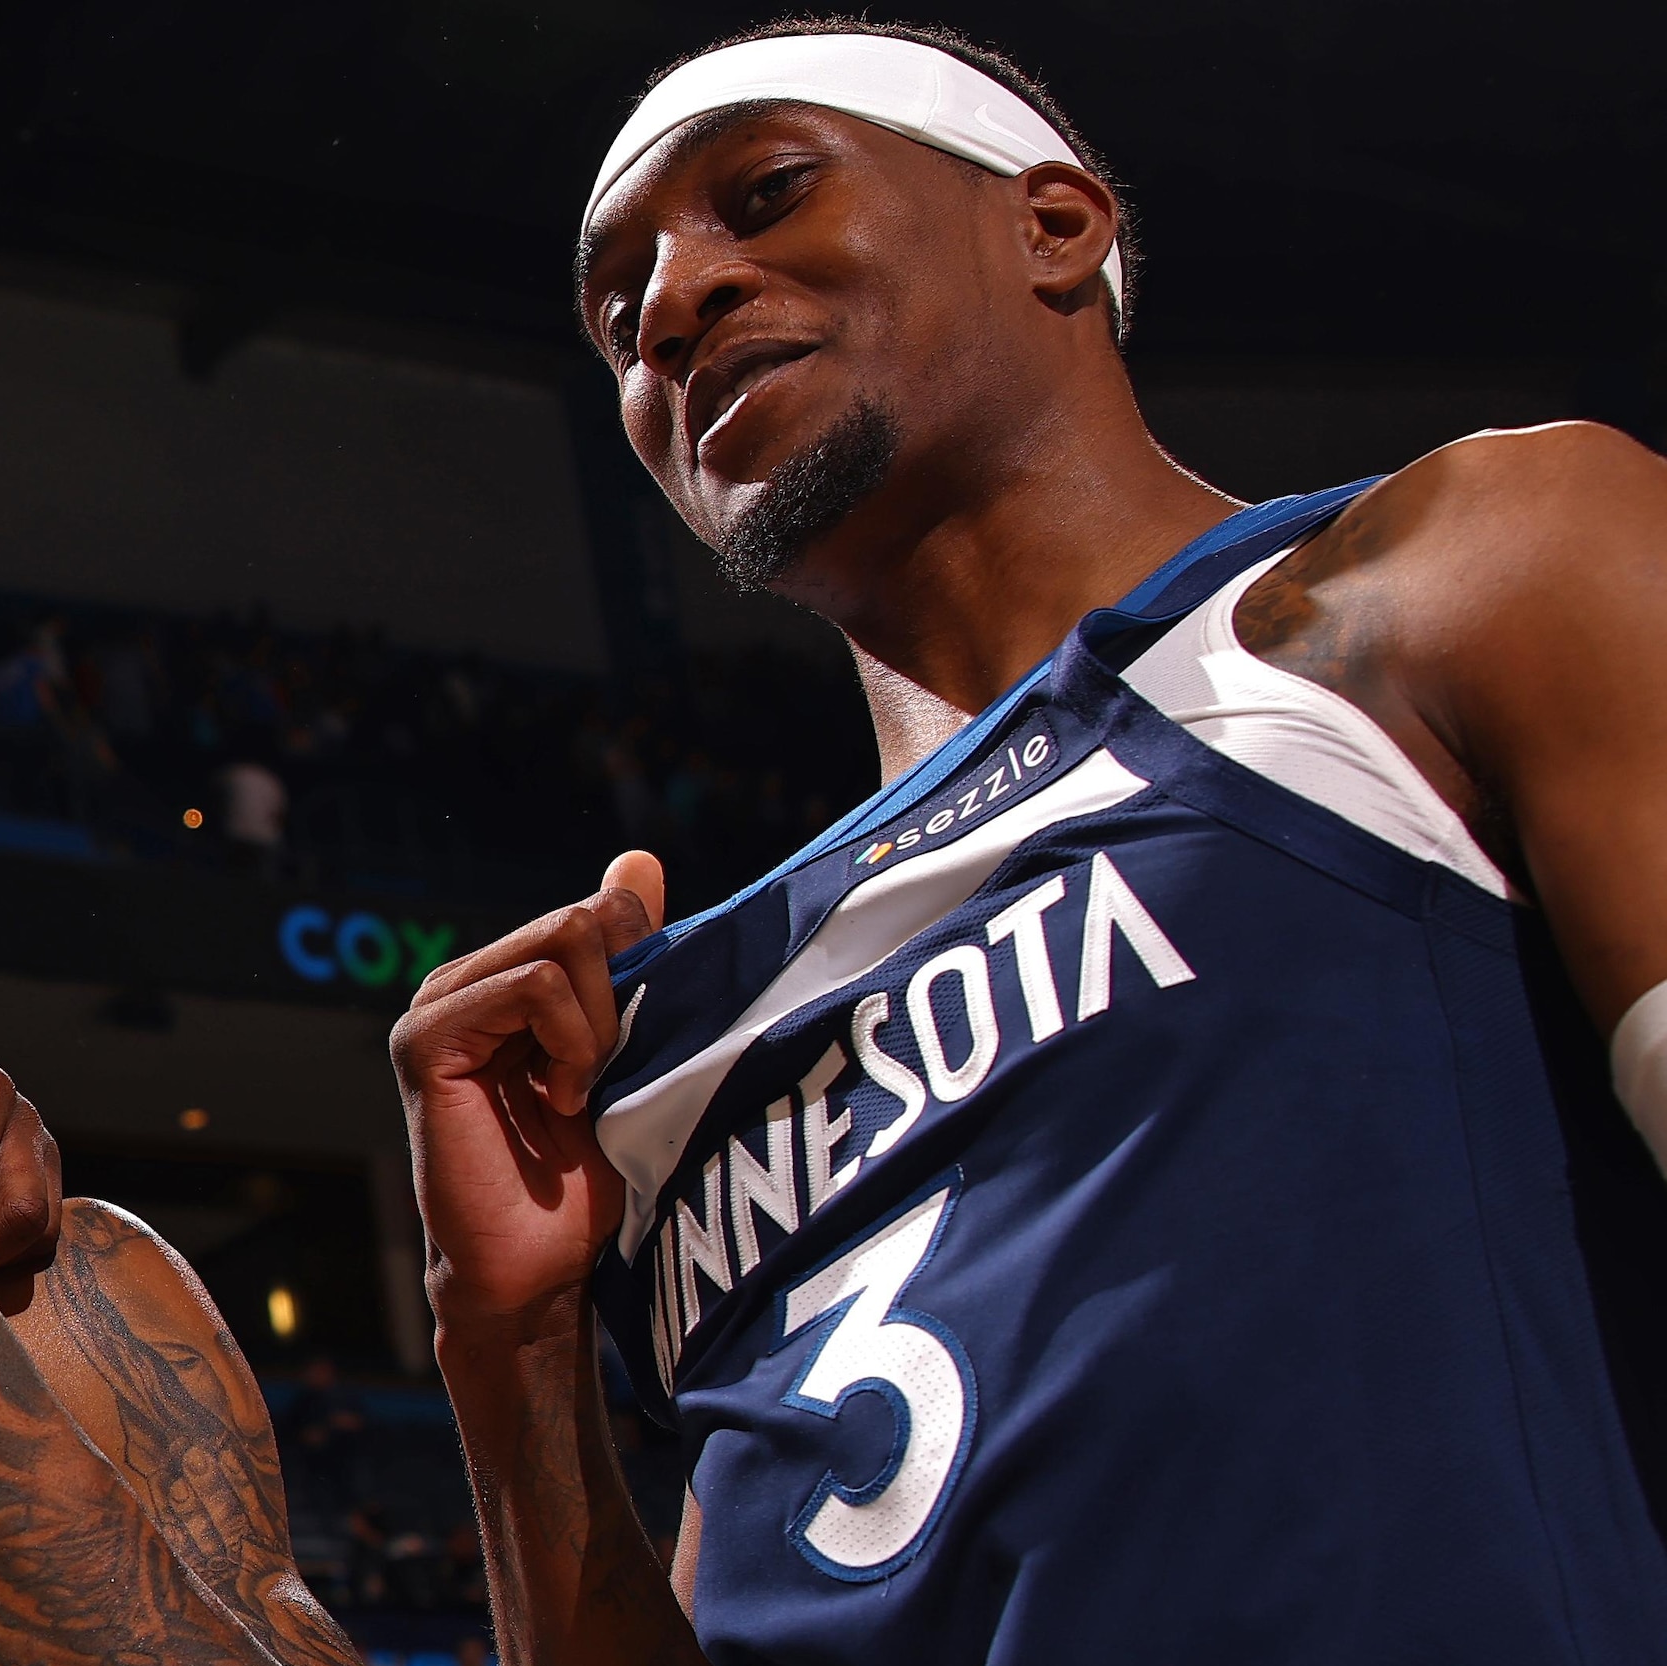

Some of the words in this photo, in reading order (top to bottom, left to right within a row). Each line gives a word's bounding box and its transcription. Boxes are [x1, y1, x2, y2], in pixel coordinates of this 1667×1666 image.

[896, 734, 1049, 851] sezzle
[277, 903, 459, 990] COX
[773, 1162, 980, 1584] 3
